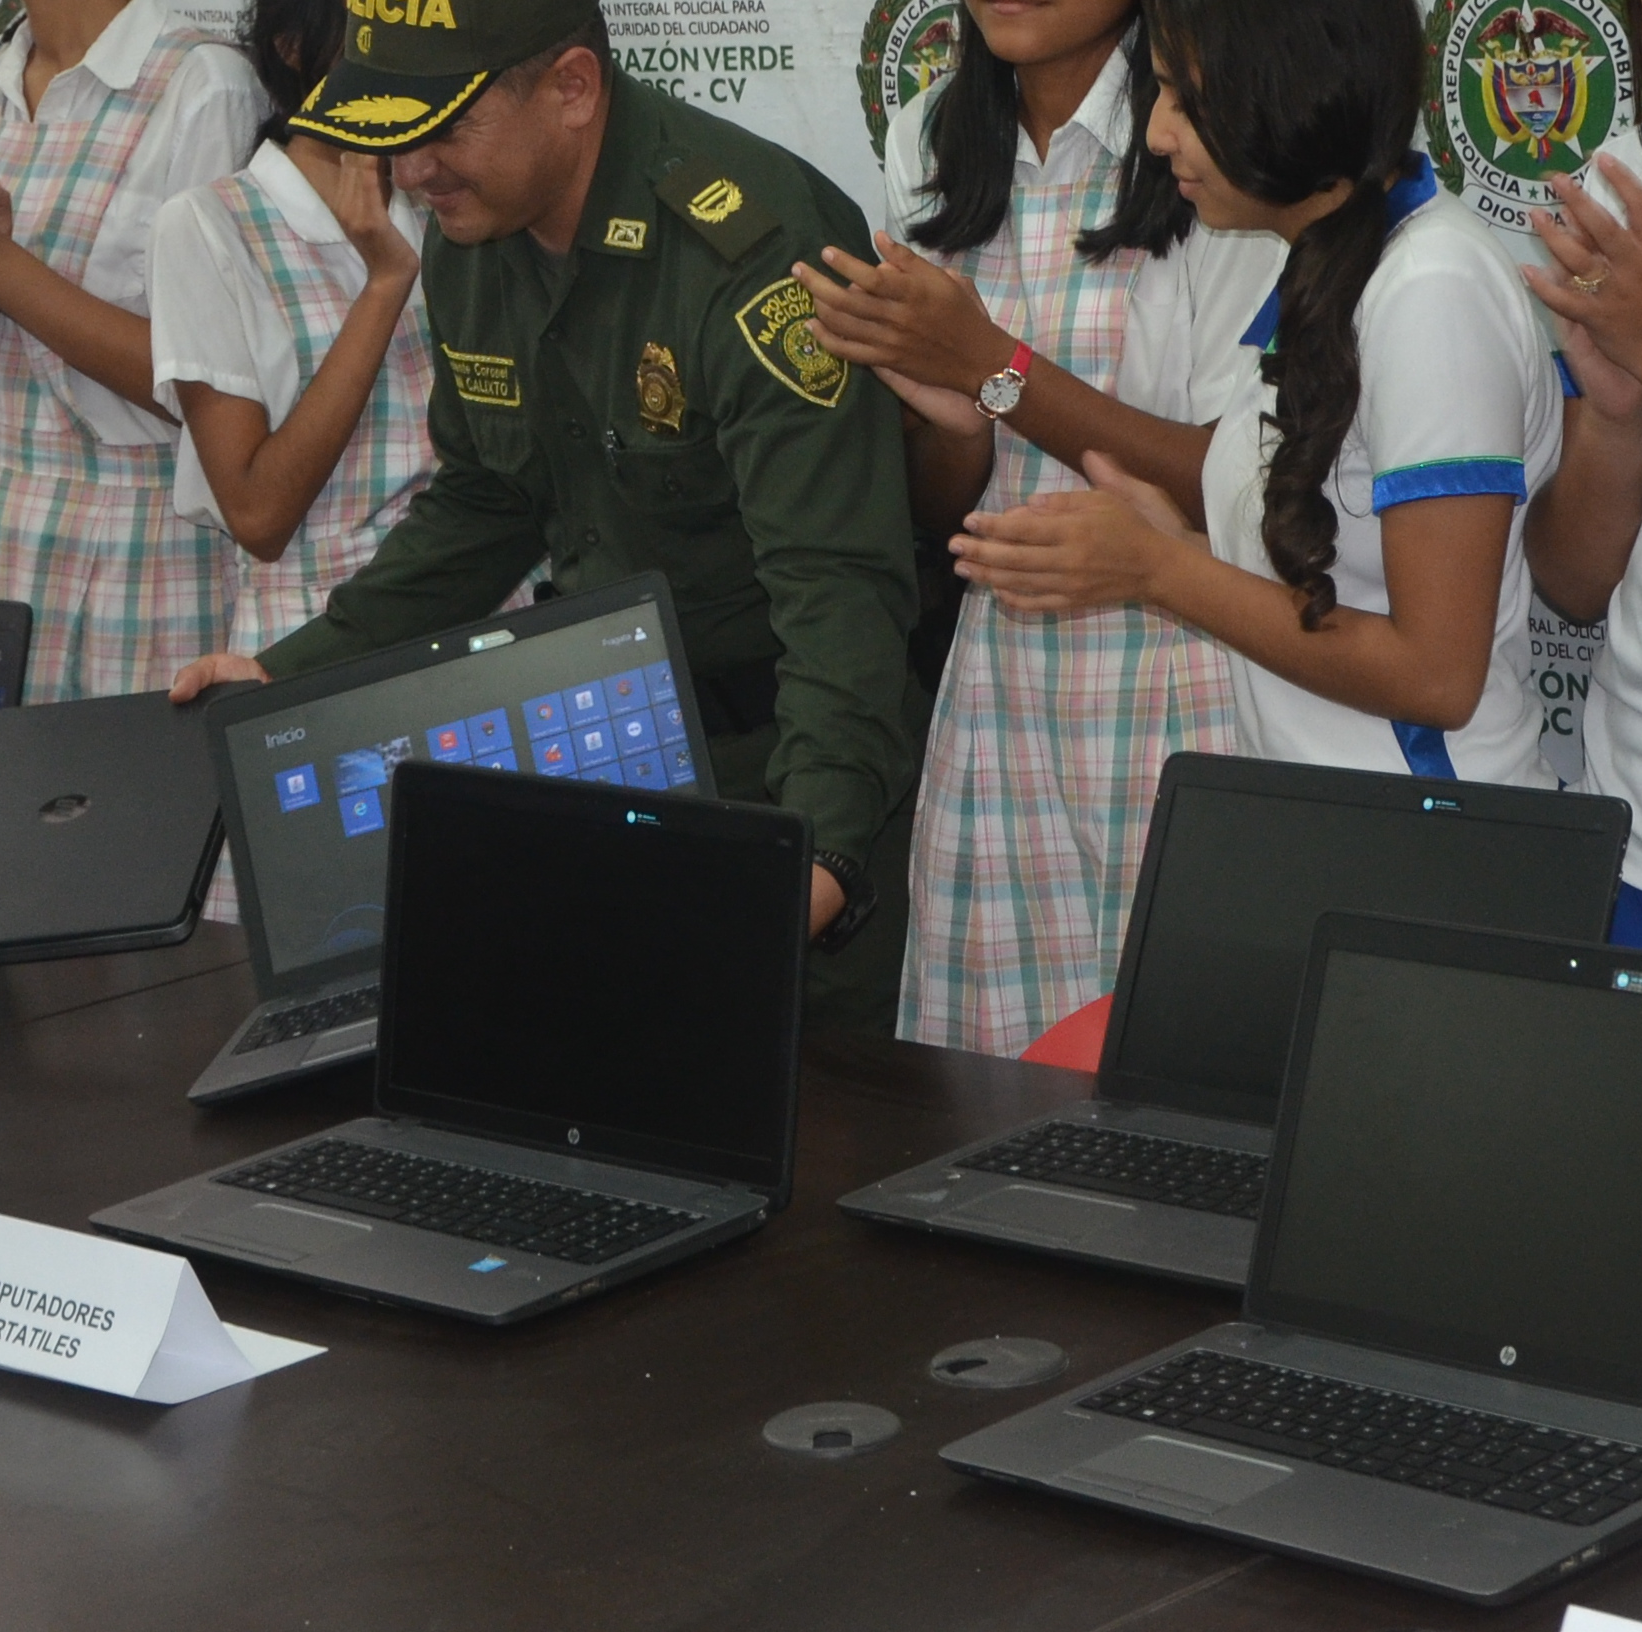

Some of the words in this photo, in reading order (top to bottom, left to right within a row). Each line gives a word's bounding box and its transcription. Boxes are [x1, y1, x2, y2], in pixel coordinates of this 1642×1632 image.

[614, 1, 670, 17] INTEGRAL
[674, 0, 729, 15] POLICIAL
[733, 0, 765, 13] PARA
[608, 22, 660, 36] GURIDAD
[663, 21, 685, 36] DEL
[689, 20, 770, 35] CIUDADANO
[610, 40, 699, 72] RAZÓN
[703, 45, 794, 72] VERDE
[709, 78, 747, 103] CV
[1559, 620, 1606, 641] POLICI
[1547, 642, 1573, 659] DEL
[265, 727, 306, 749] Inicio
